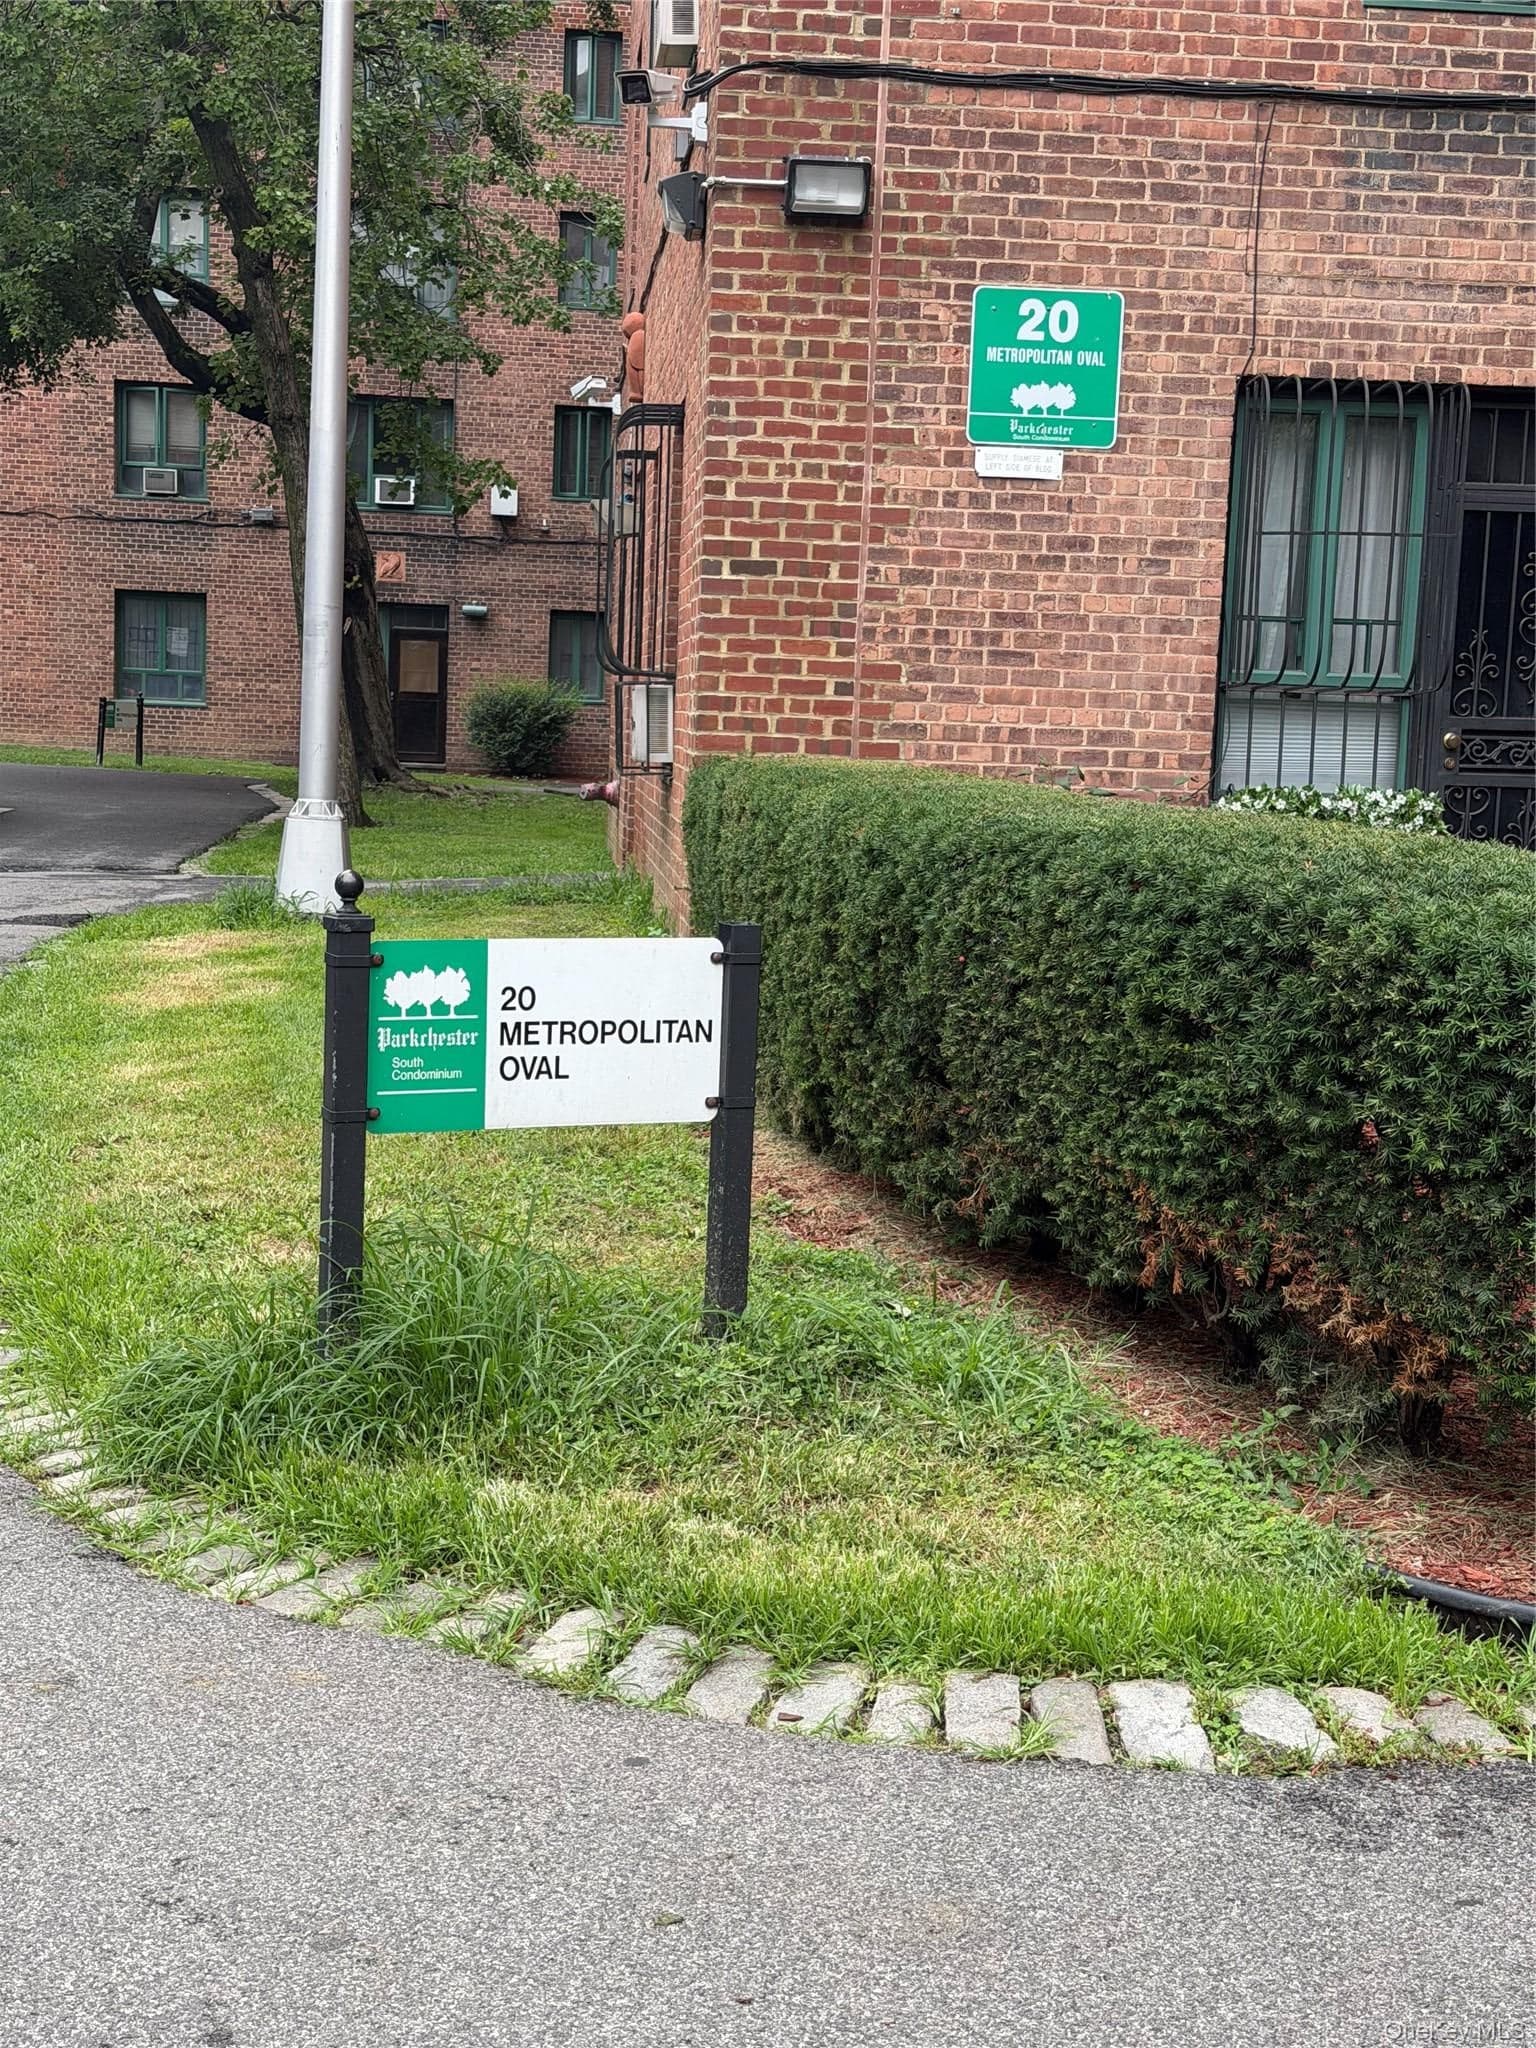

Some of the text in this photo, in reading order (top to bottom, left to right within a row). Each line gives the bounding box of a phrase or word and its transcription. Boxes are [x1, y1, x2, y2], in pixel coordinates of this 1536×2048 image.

[1016, 298, 1079, 343] 20
[986, 346, 1106, 367] METROPOLITAN OVAL
[985, 462, 1002, 471] LEFT
[501, 986, 536, 1011] 20
[377, 1027, 479, 1052] Parkchester
[499, 1019, 713, 1046] METROPOLITAN
[391, 1056, 424, 1069] South
[391, 1068, 463, 1081] Condominium
[499, 1055, 569, 1081] OVAL
